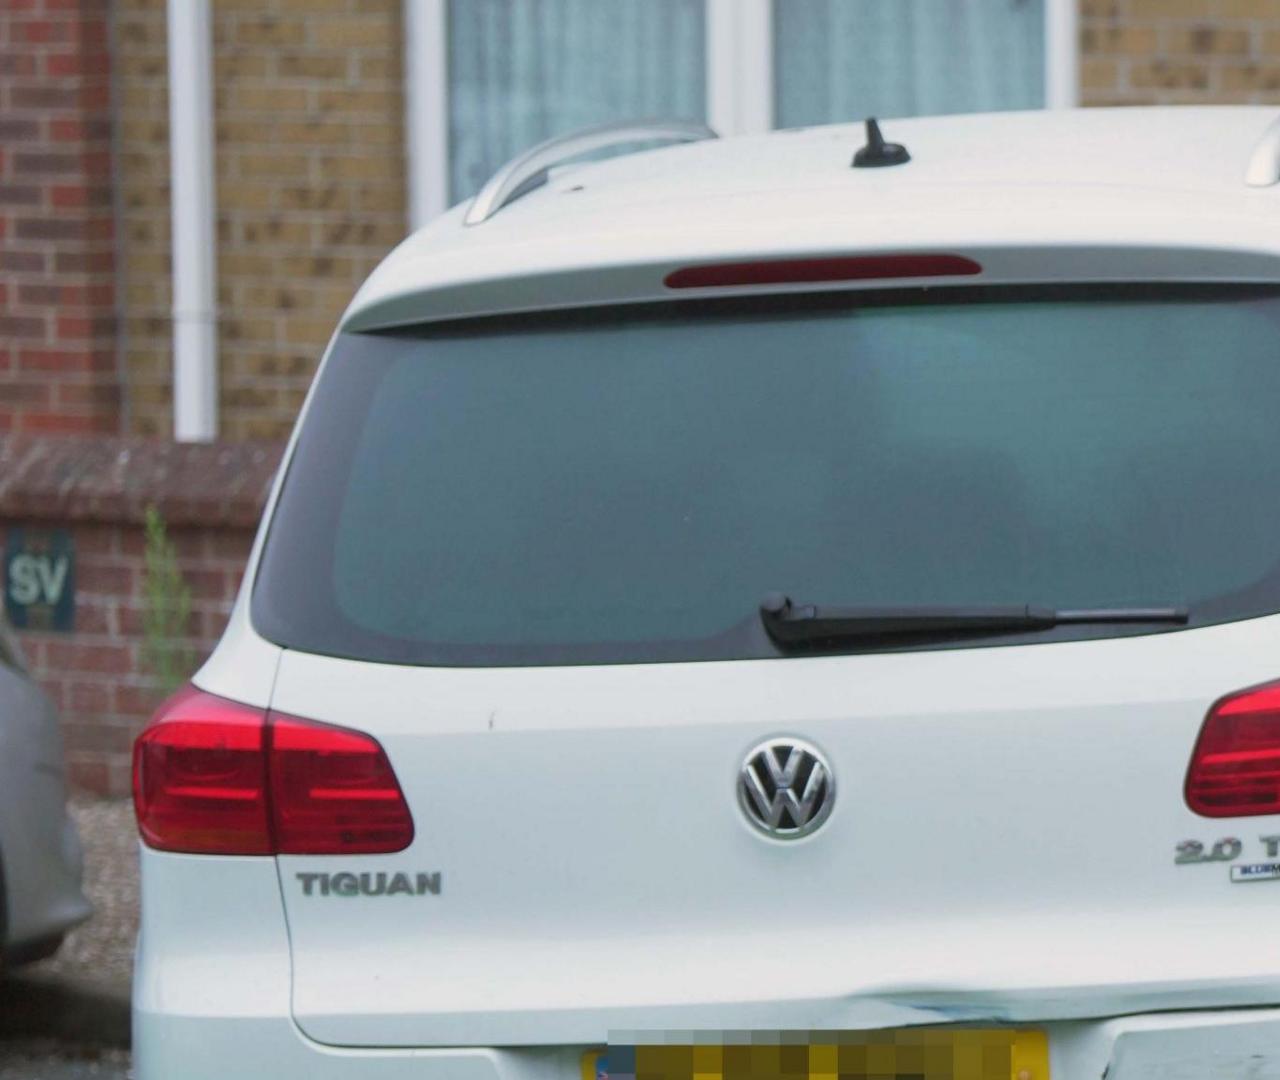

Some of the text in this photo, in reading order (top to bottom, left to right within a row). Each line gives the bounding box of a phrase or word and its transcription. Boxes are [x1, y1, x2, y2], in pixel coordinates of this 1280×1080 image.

[9, 554, 69, 605] SV
[1175, 837, 1242, 864] 2.0
[295, 871, 442, 897] TIGUAN
